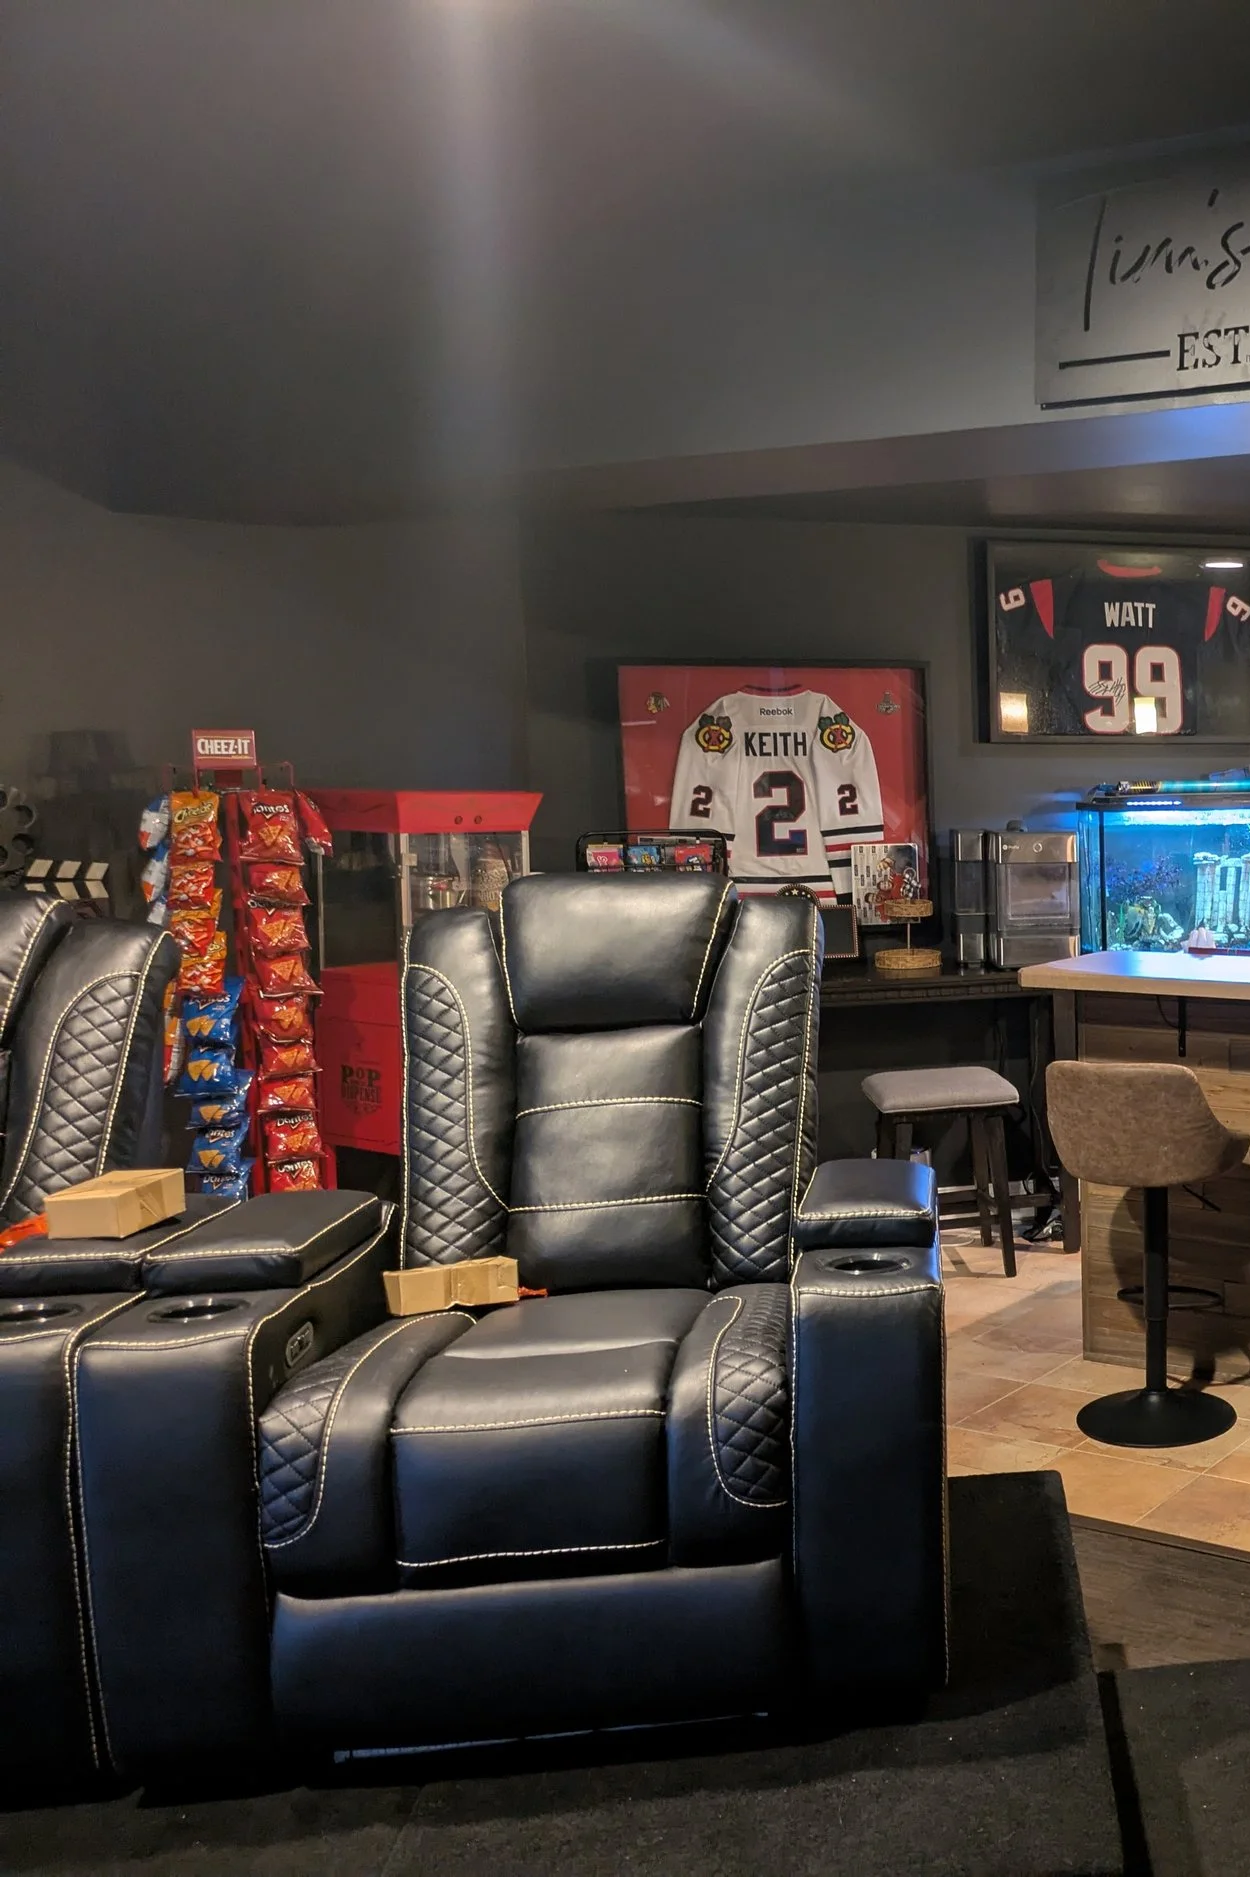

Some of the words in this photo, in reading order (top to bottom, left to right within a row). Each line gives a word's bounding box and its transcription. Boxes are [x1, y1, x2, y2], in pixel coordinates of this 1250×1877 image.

[1103, 601, 1156, 629] WATT
[1082, 643, 1184, 735] 99
[759, 707, 793, 716] Reebok
[197, 738, 250, 755] CHEEZ-IT
[744, 732, 807, 757] KEITH
[689, 784, 713, 818] 2
[837, 783, 859, 816] 2
[753, 770, 808, 857] 2
[341, 1064, 382, 1087] POP
[276, 1113, 314, 1127] Doritos
